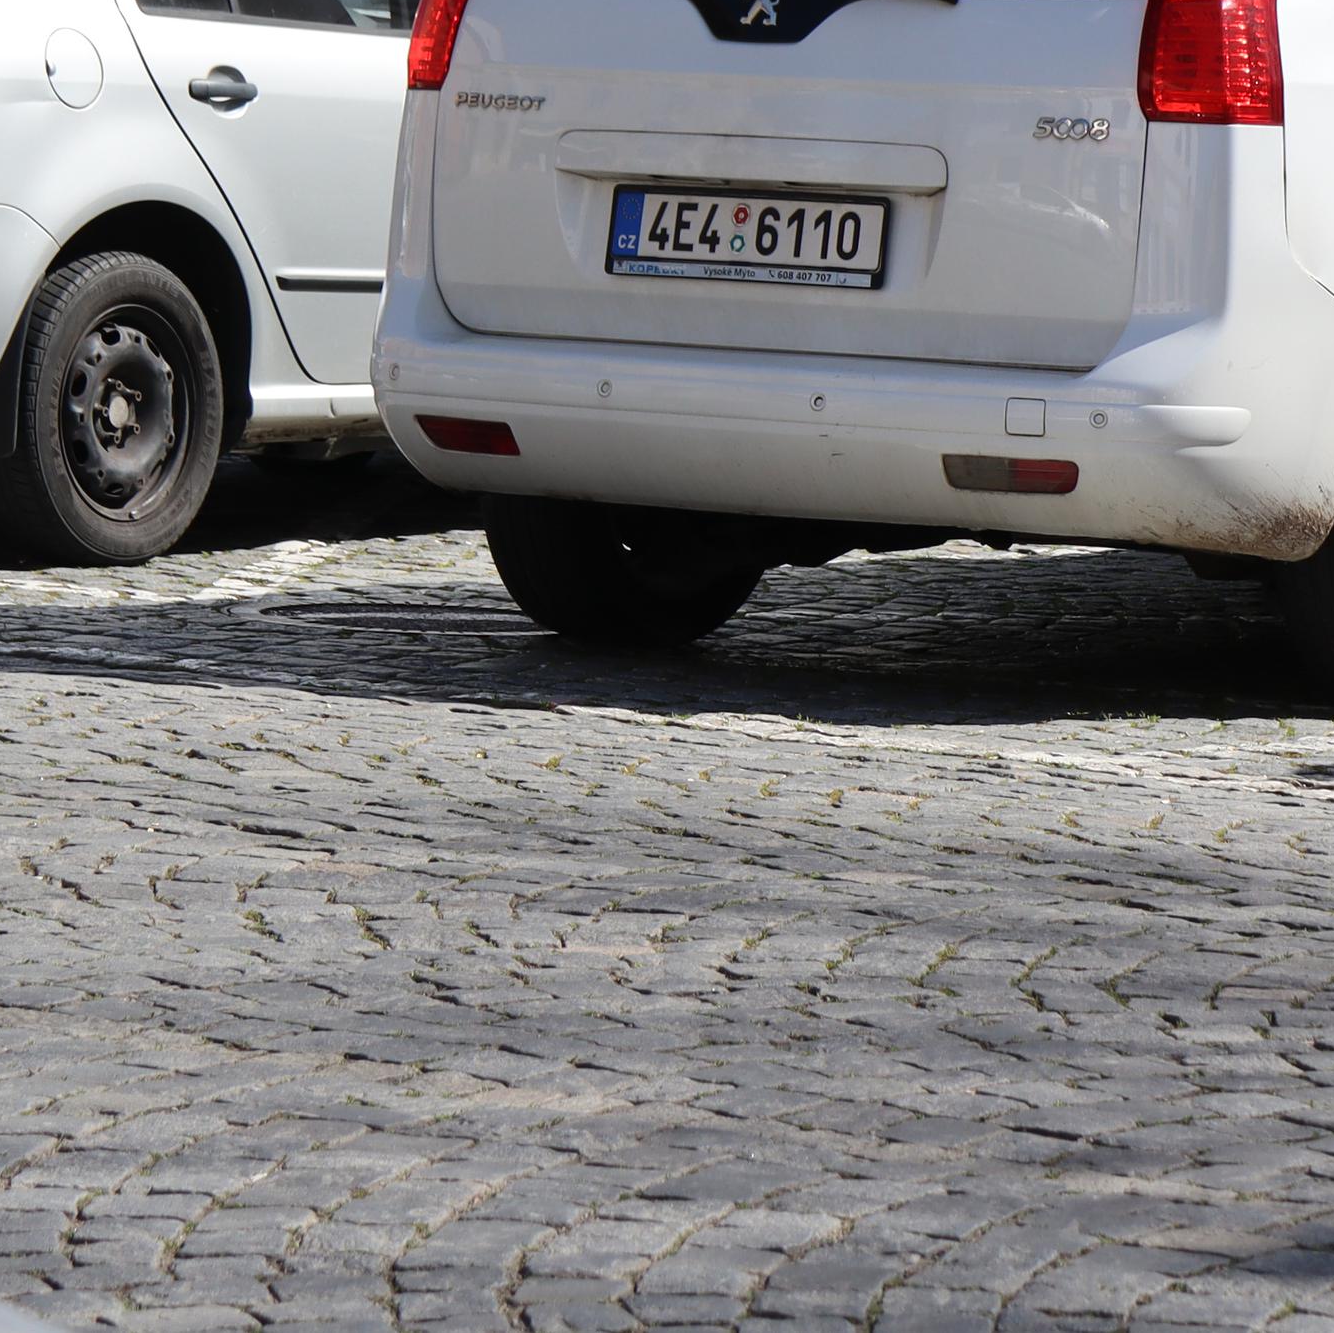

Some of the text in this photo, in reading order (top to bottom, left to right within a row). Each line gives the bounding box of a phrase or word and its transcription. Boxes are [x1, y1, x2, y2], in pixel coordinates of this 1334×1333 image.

[454, 91, 546, 111] PEUGEOT
[1032, 116, 1111, 142] 5008
[648, 201, 862, 260] 4E4 6110
[617, 234, 637, 250] CZ
[703, 265, 732, 277] Vysoké
[733, 267, 756, 279] Mýto
[777, 270, 794, 280] 608
[795, 271, 812, 281] 407
[815, 272, 832, 282] 707
